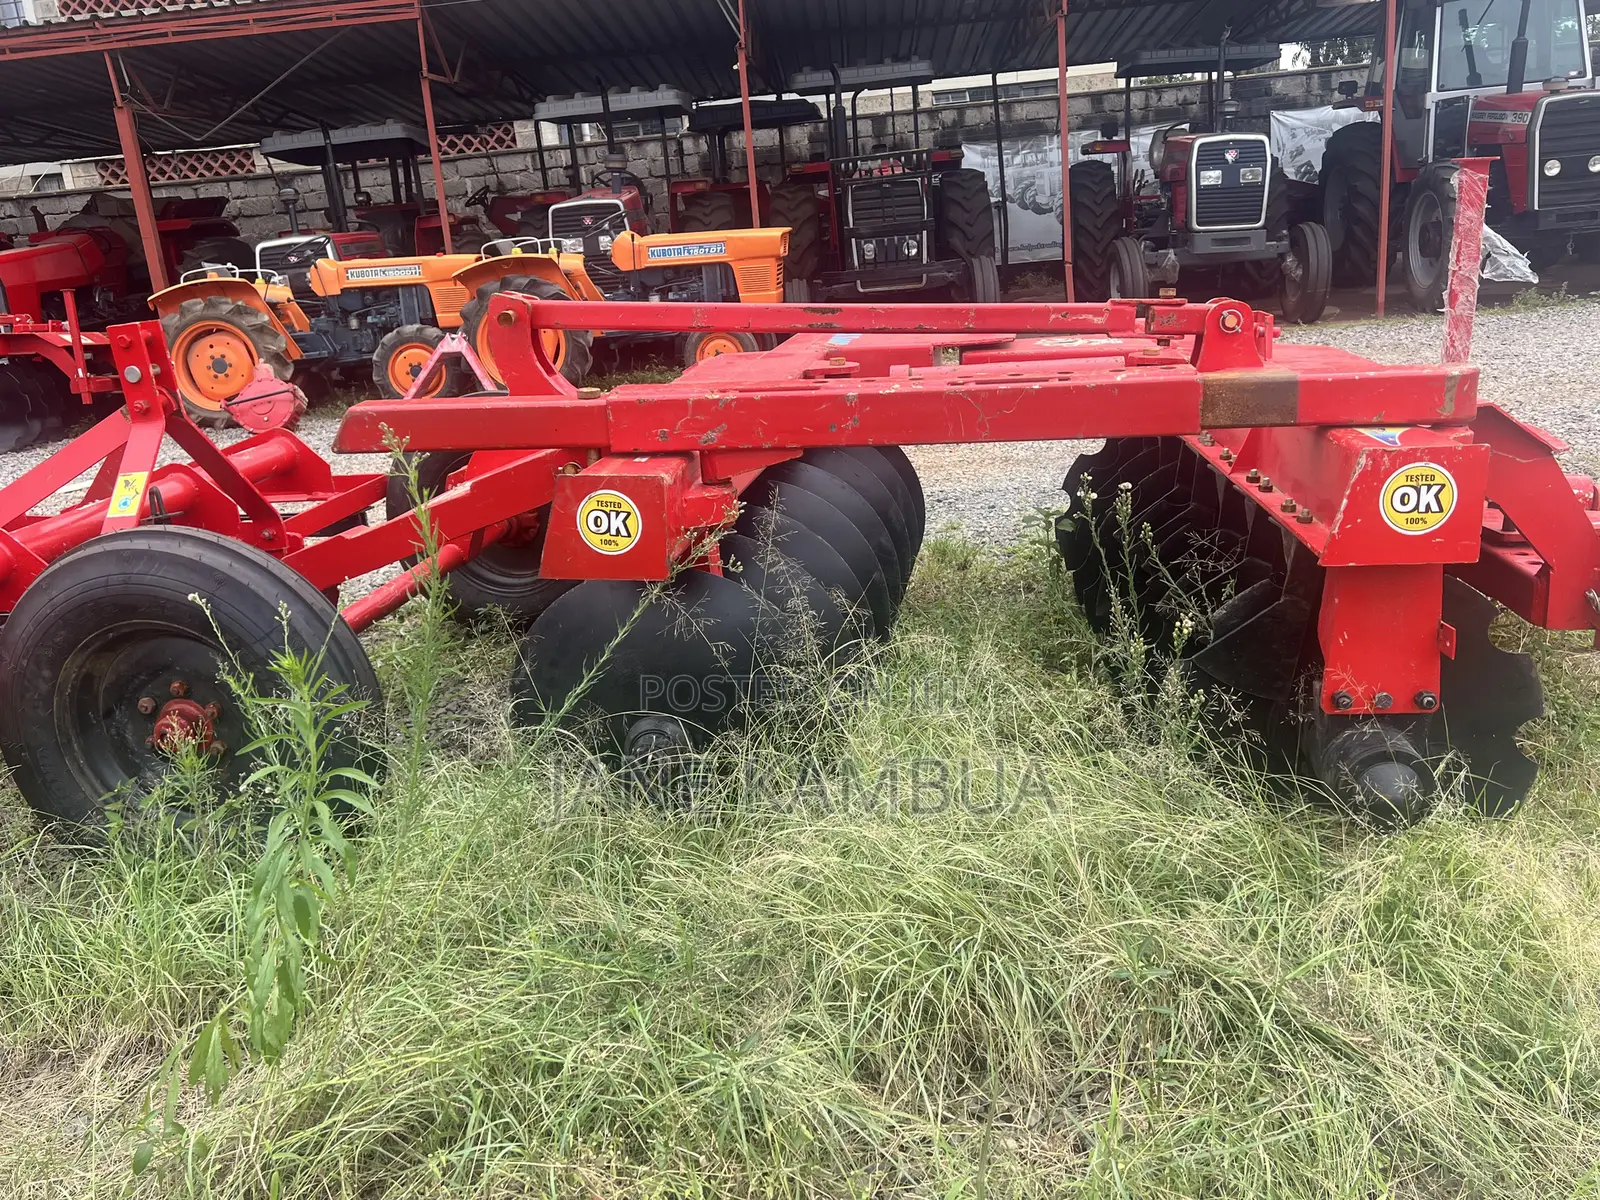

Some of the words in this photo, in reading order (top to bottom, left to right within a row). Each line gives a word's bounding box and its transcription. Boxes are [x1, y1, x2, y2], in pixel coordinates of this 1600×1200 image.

[1511, 112, 1529, 123] 390
[650, 247, 682, 258] KUBOTA
[350, 269, 379, 279] KUBOTA
[1405, 474, 1435, 482] TESTED
[1391, 483, 1446, 514] OK
[596, 500, 622, 509] TESTED
[586, 509, 632, 538] OK
[1404, 517, 1428, 525] 100%
[600, 539, 619, 547] 100%
